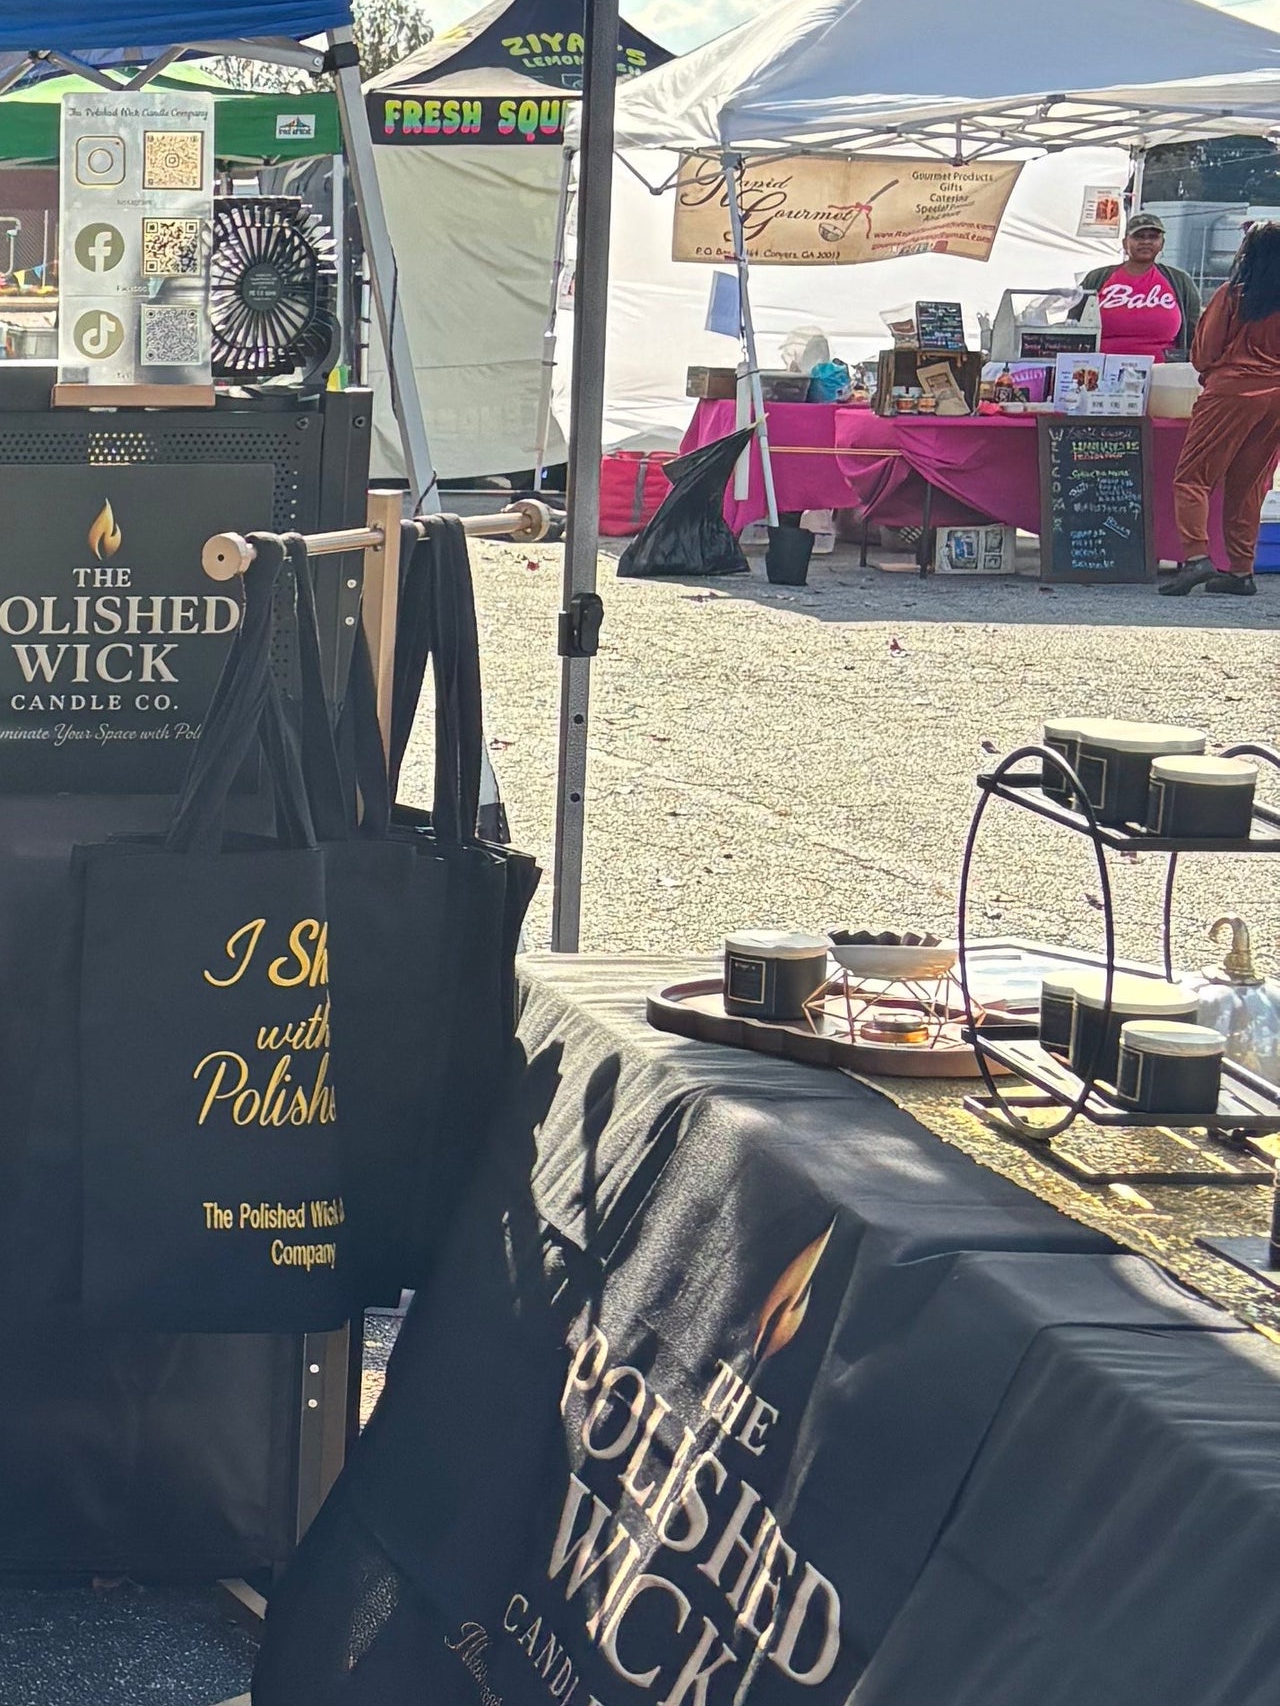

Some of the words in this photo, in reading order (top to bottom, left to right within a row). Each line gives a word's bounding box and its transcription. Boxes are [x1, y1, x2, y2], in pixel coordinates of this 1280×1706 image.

[501, 32, 648, 66] ZIYA'S
[384, 99, 482, 134] FRESH
[912, 171, 951, 181] Gourmet
[953, 170, 993, 182] Products
[940, 182, 963, 192] Gifts
[1098, 283, 1177, 309] Babe
[72, 568, 131, 588] THE
[11, 643, 179, 683] WICK
[10, 694, 122, 711] CANDLE
[134, 694, 179, 711] CO.
[54, 723, 92, 746] Your
[95, 723, 137, 746] Space
[140, 724, 170, 740] with
[203, 918, 266, 987] I
[257, 989, 331, 1050] with
[202, 1202, 233, 1229] The
[240, 1201, 305, 1229] Polished
[271, 1239, 336, 1272] Company
[701, 1358, 779, 1456] THE
[560, 1324, 841, 1686] POLISHED
